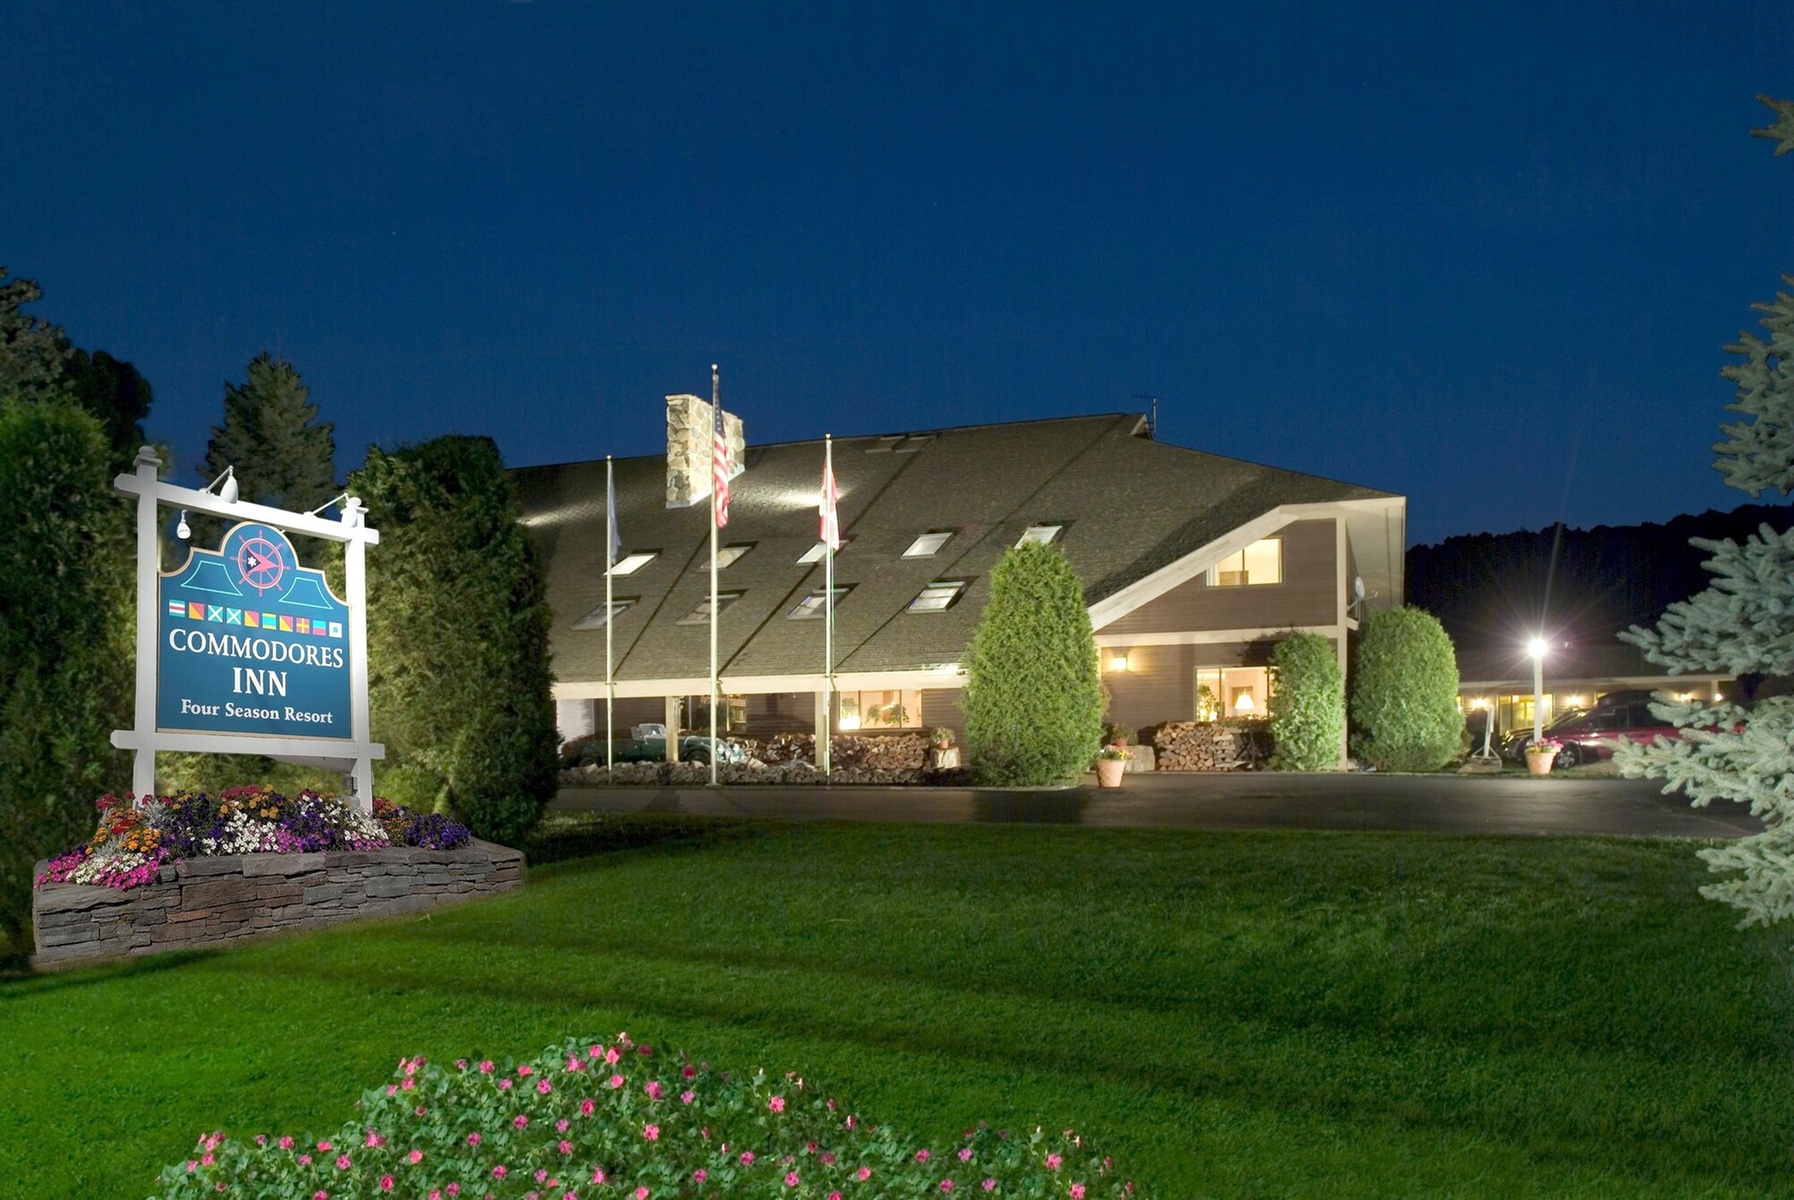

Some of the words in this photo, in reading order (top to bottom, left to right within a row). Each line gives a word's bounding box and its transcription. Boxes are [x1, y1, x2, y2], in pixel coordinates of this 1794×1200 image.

[169, 628, 344, 668] COMMODORES
[232, 667, 287, 697] INN
[181, 699, 220, 716] Four
[225, 702, 280, 720] Season
[285, 706, 333, 724] Resort
